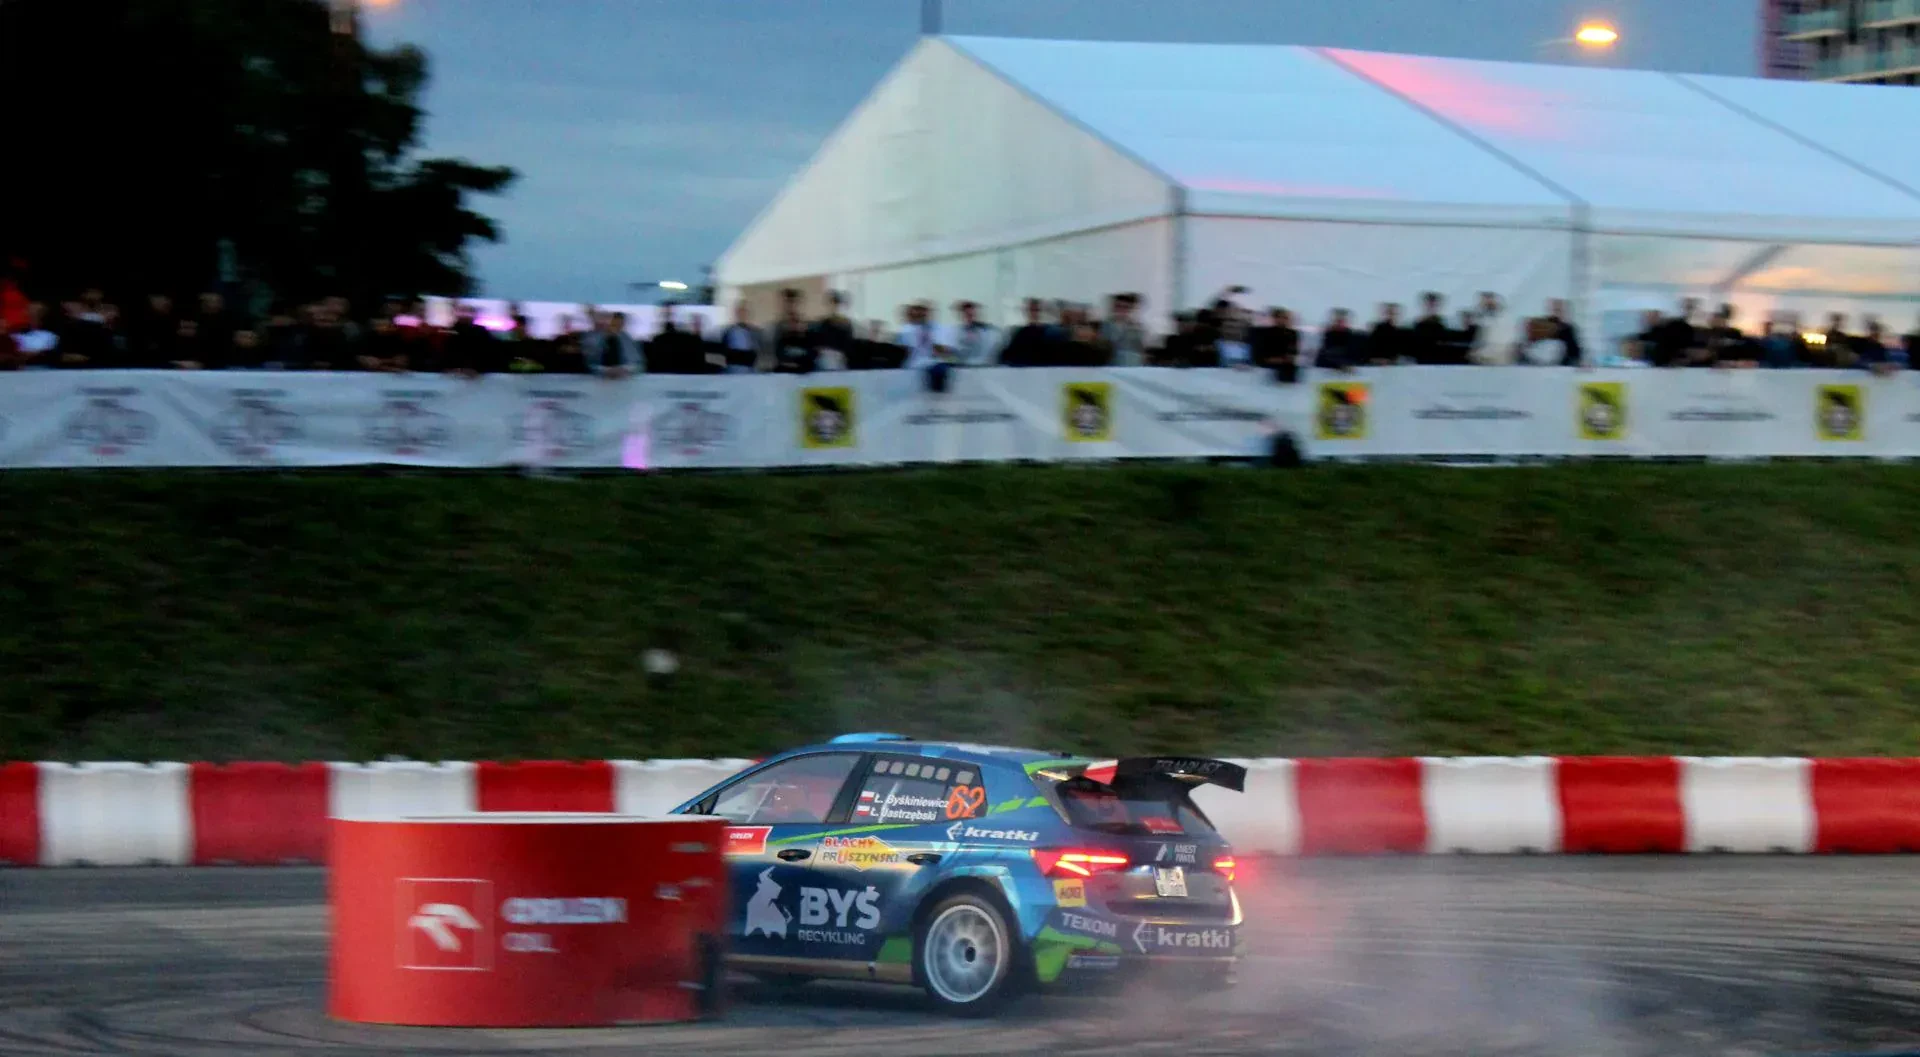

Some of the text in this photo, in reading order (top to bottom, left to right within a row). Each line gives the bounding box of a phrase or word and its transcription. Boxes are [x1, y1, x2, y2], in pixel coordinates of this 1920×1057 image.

[946, 785, 985, 819] 62
[825, 837, 876, 848] BLACHY
[964, 825, 1040, 841] kratki
[800, 886, 880, 930] BYŚ
[1061, 912, 1117, 937] TEKOM
[798, 929, 865, 945] RECYKLING
[1157, 927, 1230, 948] kratki
